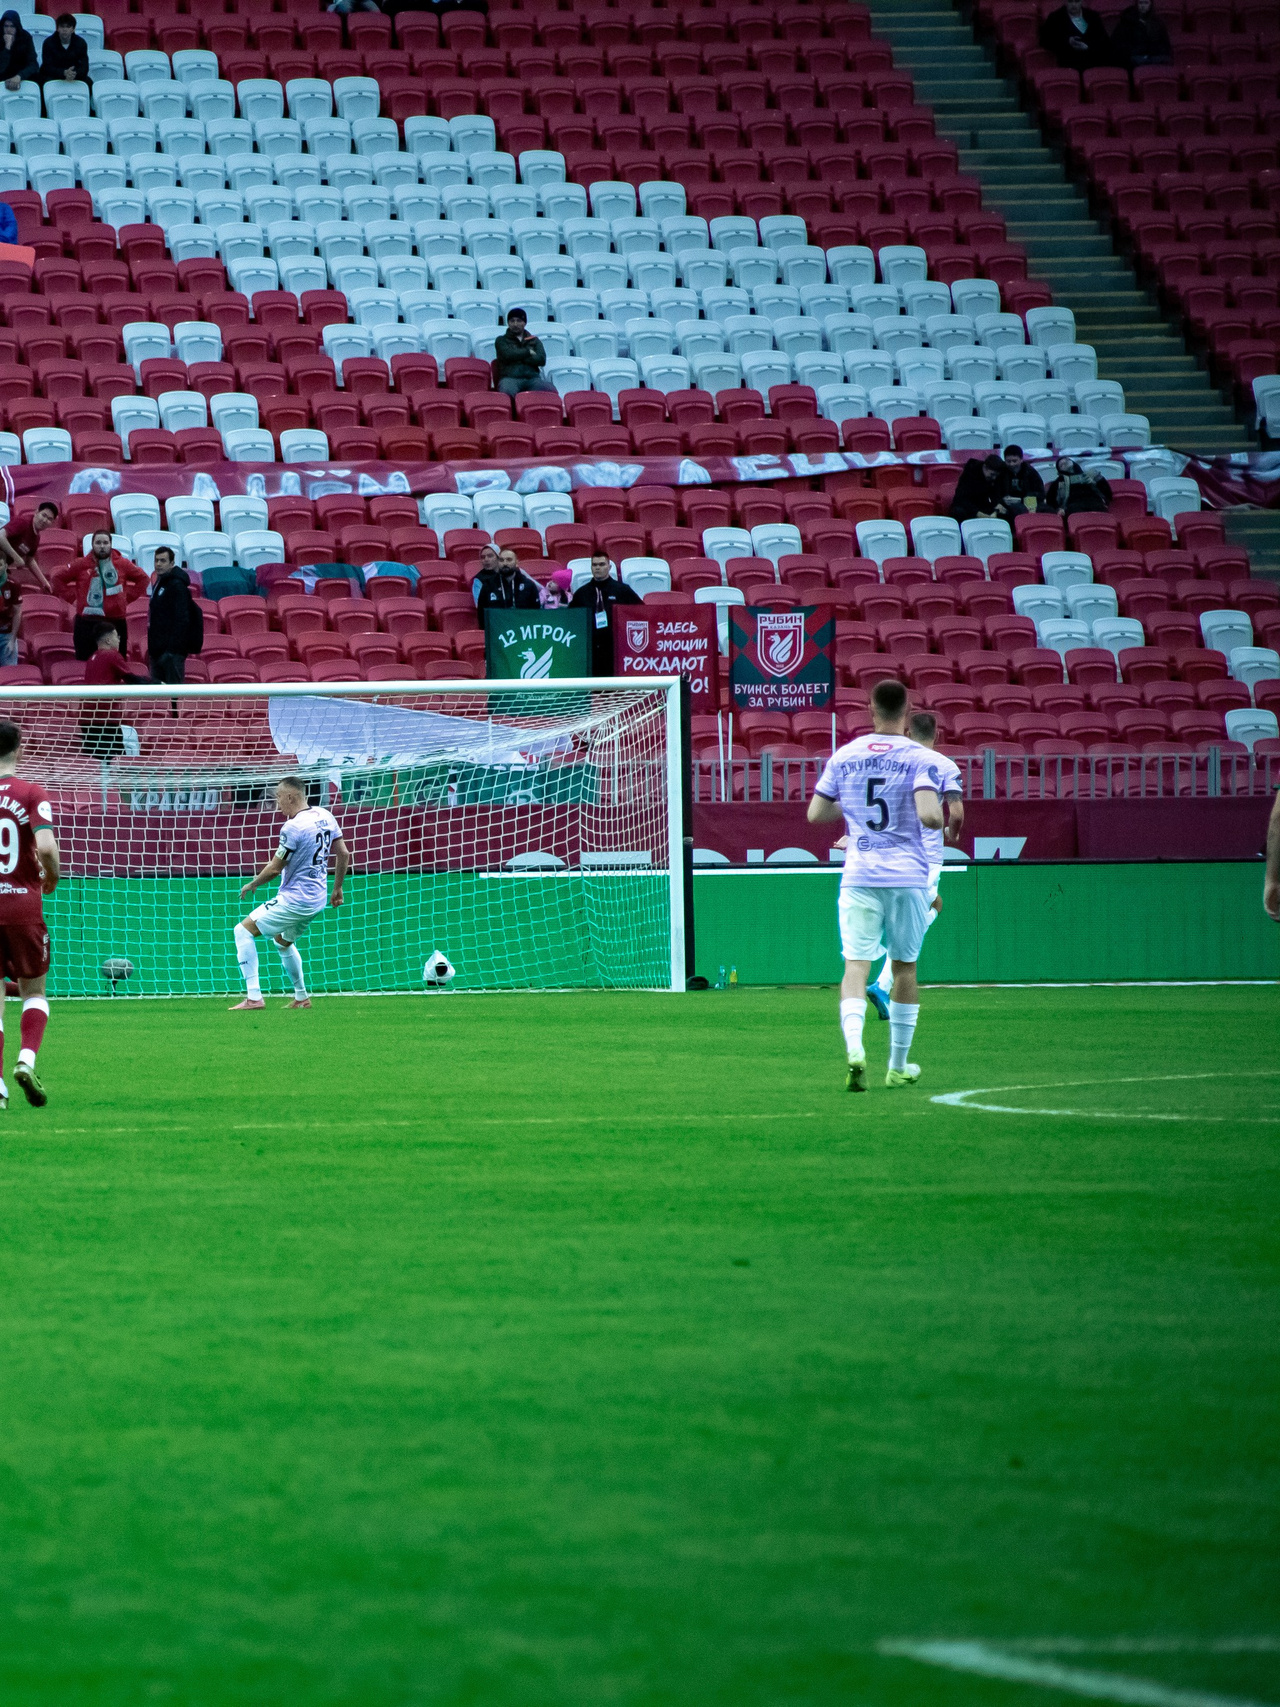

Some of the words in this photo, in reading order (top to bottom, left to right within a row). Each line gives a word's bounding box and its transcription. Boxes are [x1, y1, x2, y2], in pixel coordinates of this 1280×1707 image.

[759, 616, 803, 624] РУБИН
[656, 621, 699, 635] ЗДЕСЬ
[498, 629, 518, 648] 12
[519, 624, 577, 648] ИГРОК
[656, 637, 708, 652] ЭМОЦИИ
[623, 655, 708, 673] РОЖДАЮТ
[734, 684, 778, 695] БУИНСК
[781, 683, 829, 695] БОЛЕЕТ
[748, 696, 764, 708] ЗА
[767, 696, 806, 707] РУБИН
[865, 778, 890, 832] 5
